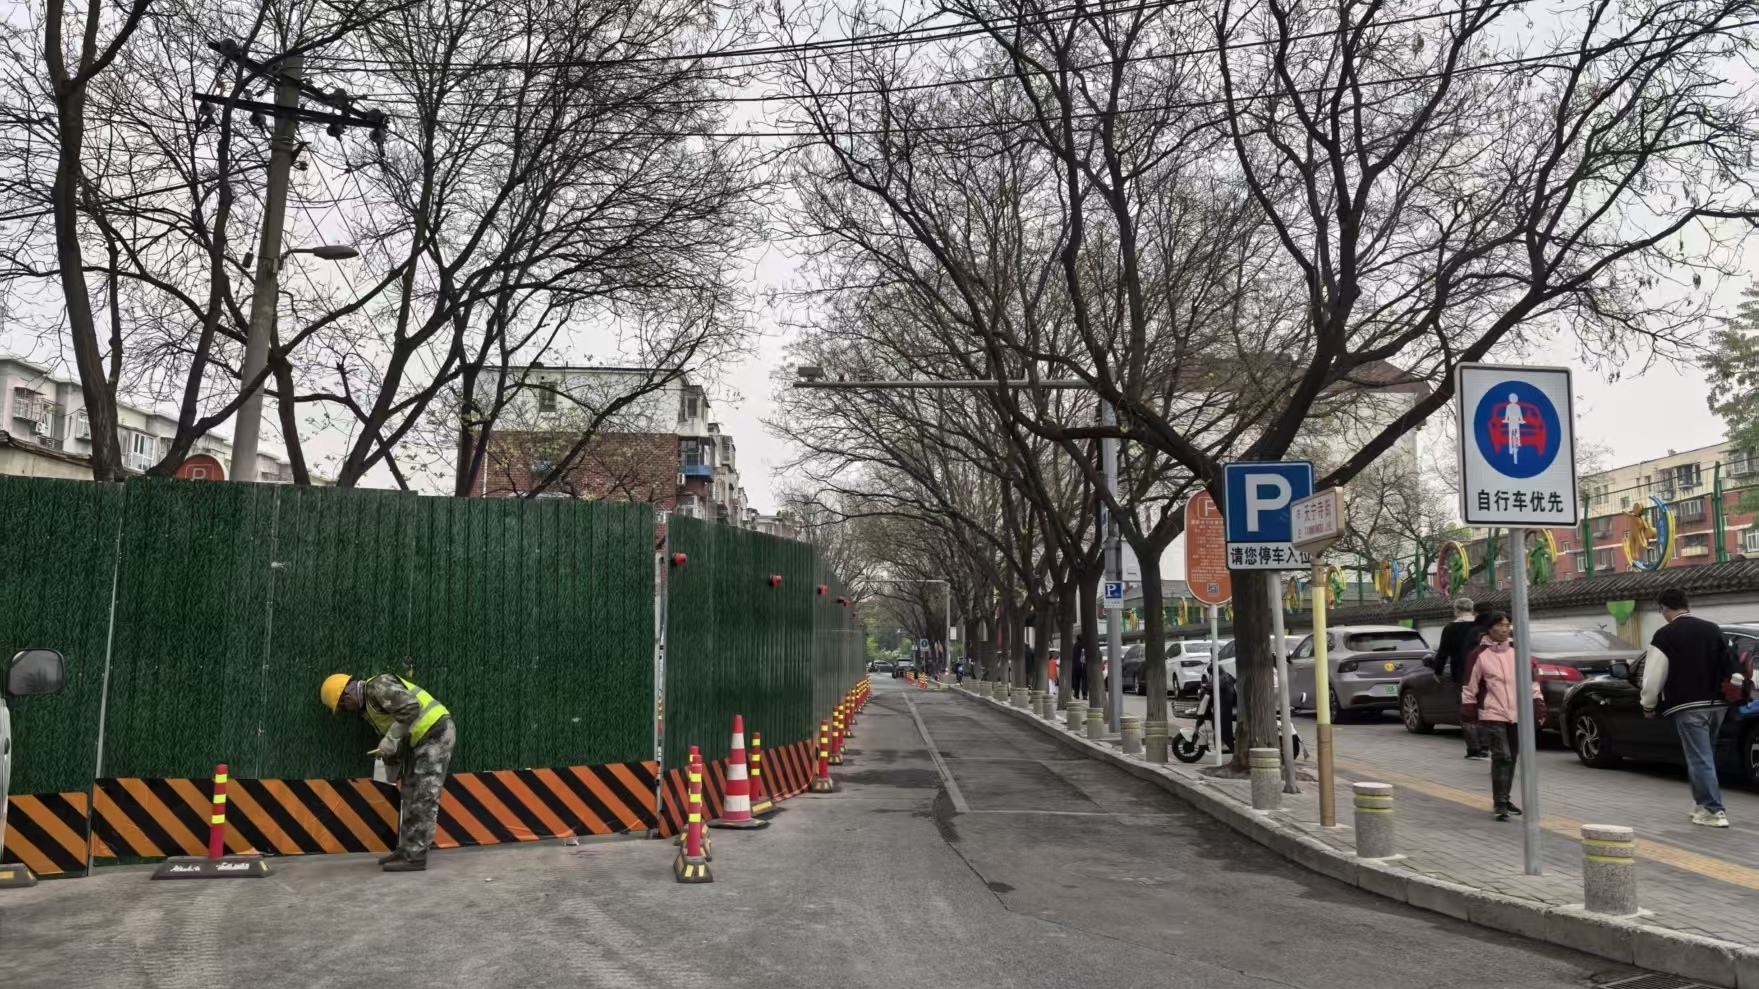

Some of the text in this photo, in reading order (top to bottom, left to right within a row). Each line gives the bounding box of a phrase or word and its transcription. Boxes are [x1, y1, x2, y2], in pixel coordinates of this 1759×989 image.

[1245, 473, 1293, 533] P
[1477, 488, 1564, 513] 自行车优先
[1230, 546, 1312, 566] 请您停车入位
[1105, 583, 1117, 597] P
